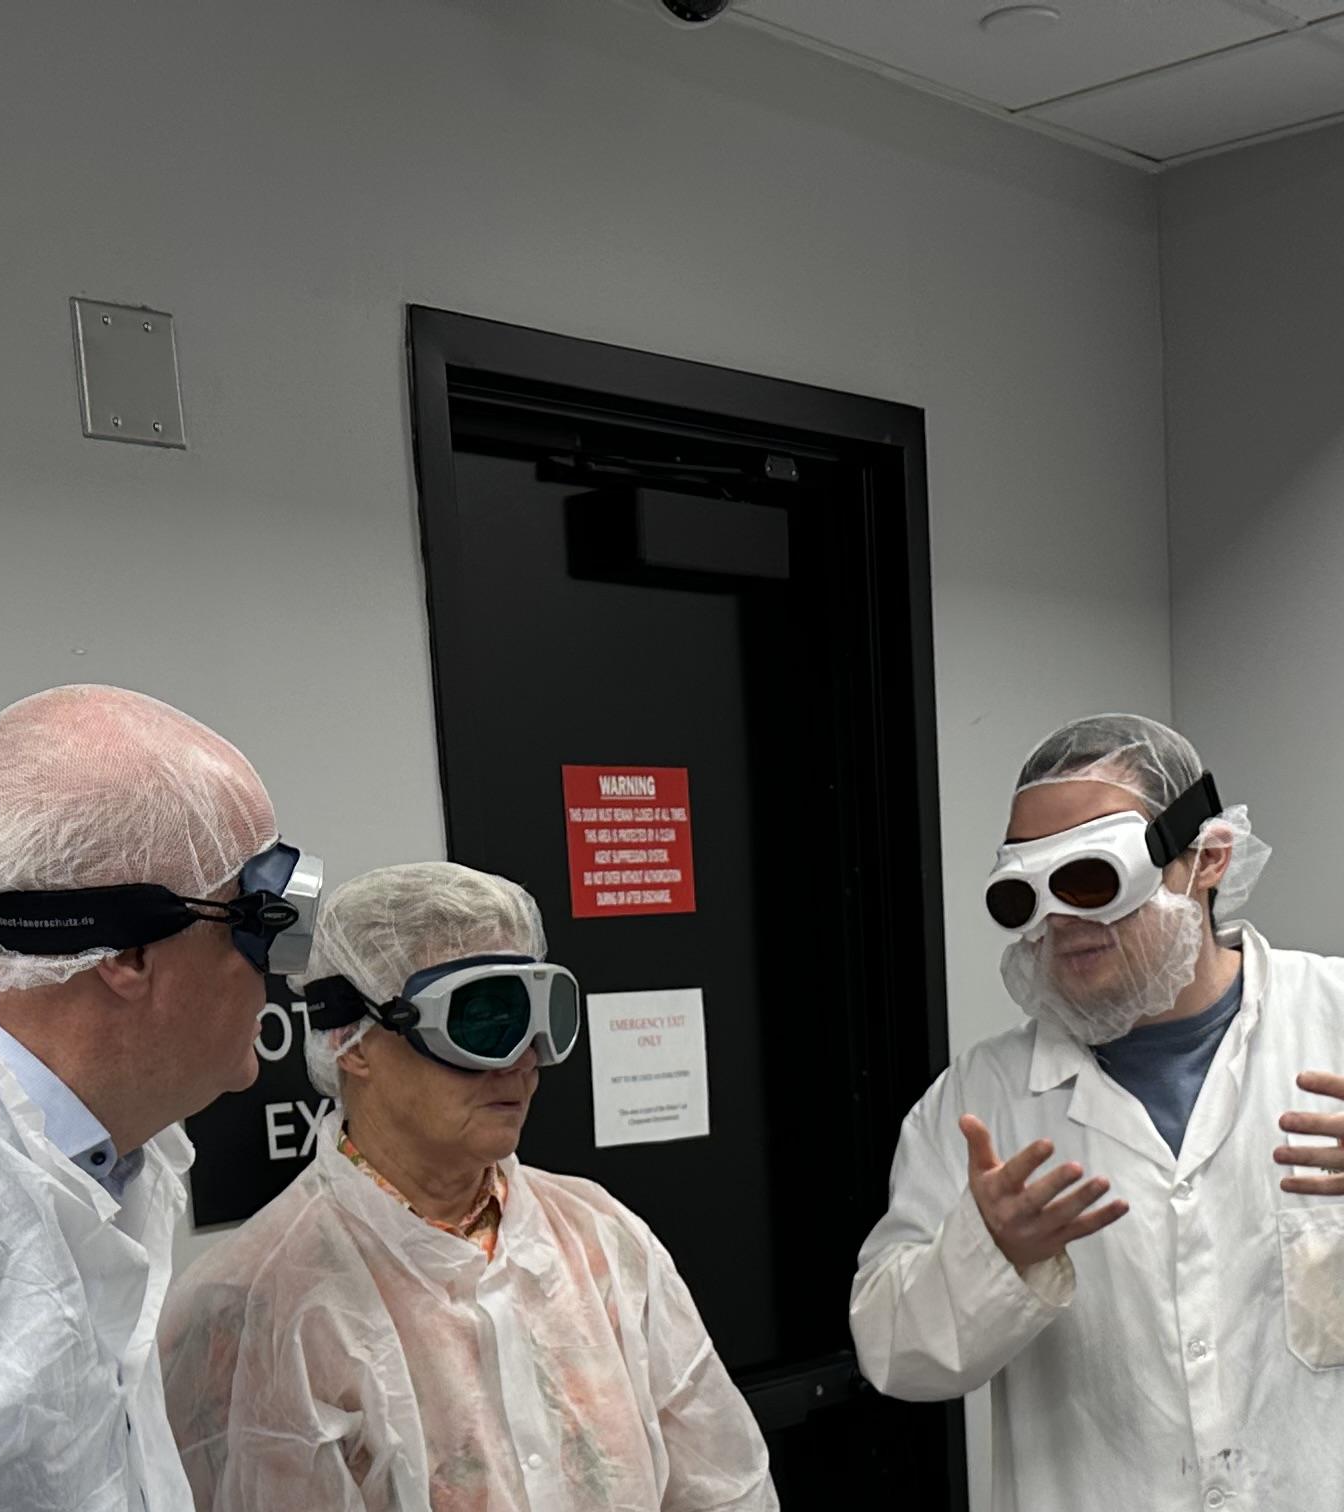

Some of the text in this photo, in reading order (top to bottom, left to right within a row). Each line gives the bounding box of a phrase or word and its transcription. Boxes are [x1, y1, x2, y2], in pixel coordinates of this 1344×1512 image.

[598, 775, 656, 796] WARNING
[254, 1001, 314, 1062] OT
[609, 1014, 686, 1031] EMERGENCY EXIT
[638, 1035, 663, 1047] ONLY
[265, 1098, 333, 1161] EX
